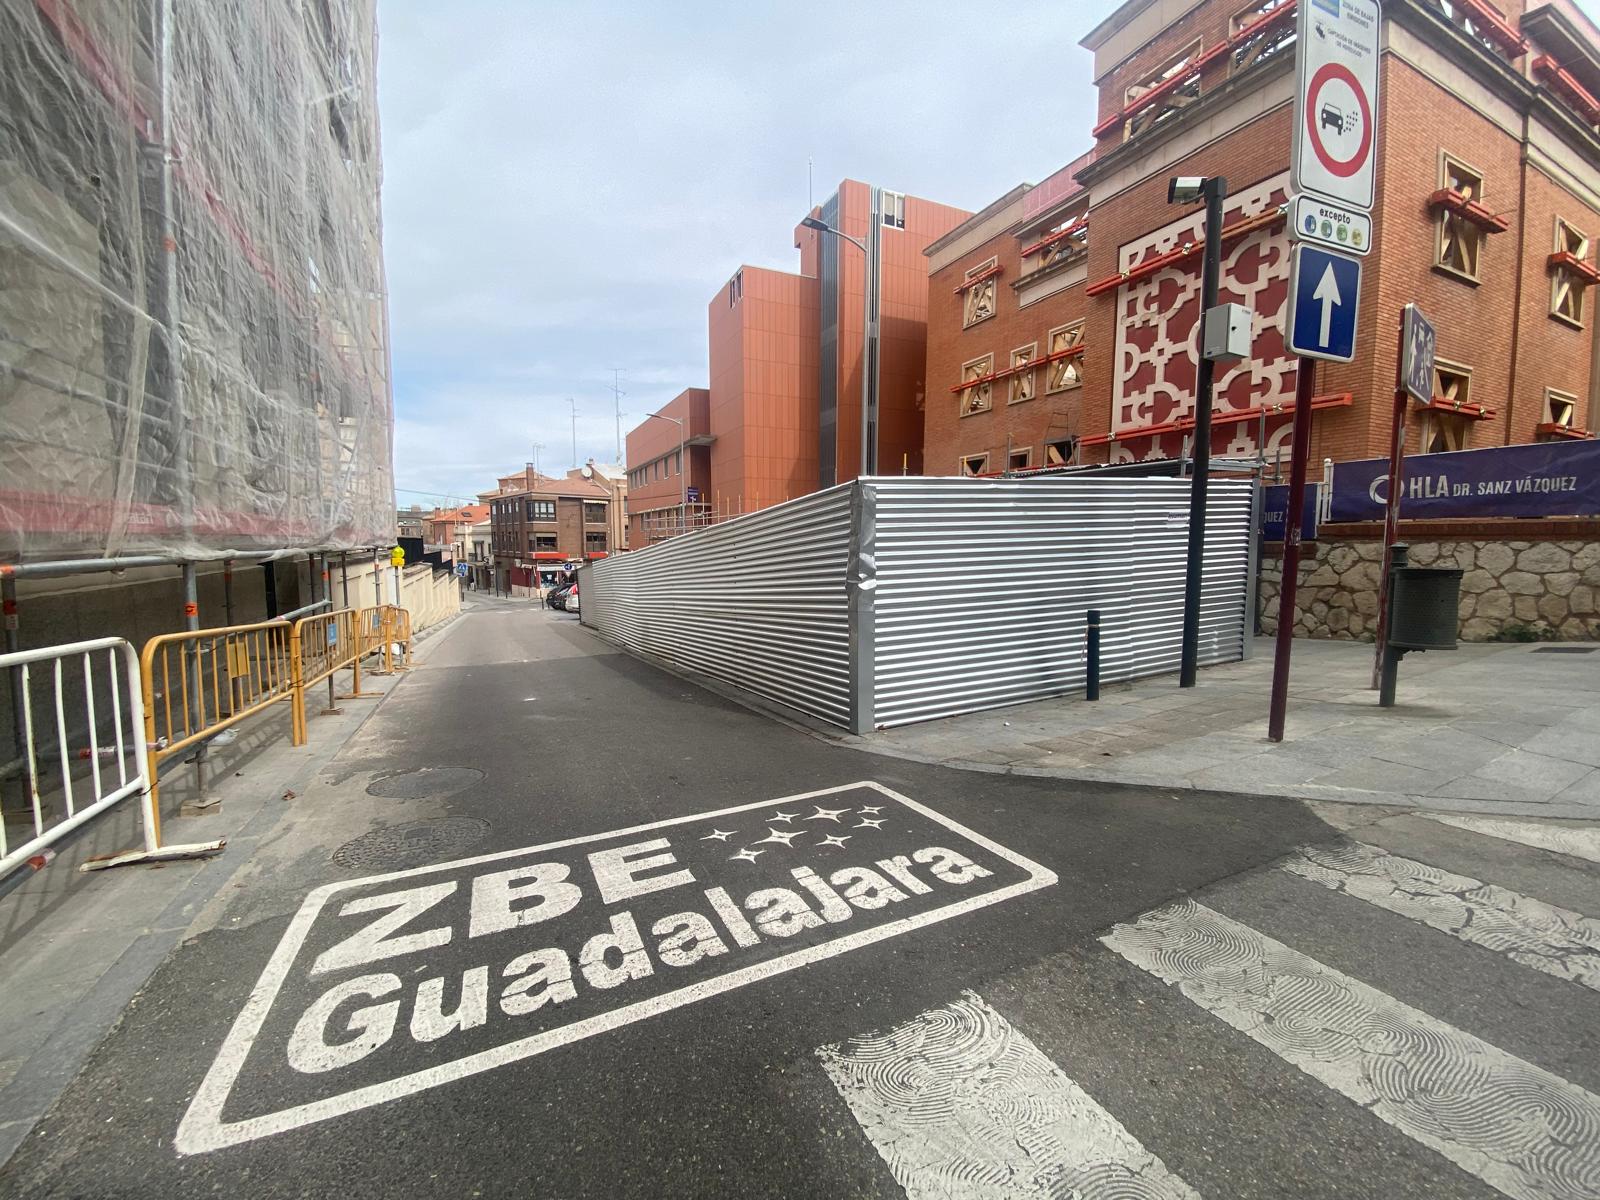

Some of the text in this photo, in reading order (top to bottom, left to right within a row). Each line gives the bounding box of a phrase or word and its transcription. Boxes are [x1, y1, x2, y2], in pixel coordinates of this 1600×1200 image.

[1319, 208, 1351, 225] excepto
[1409, 475, 1577, 499] HLA DR. SANZ VÁZQUEZ
[306, 838, 696, 982] ZBE
[286, 846, 994, 1074] Guadalajara
